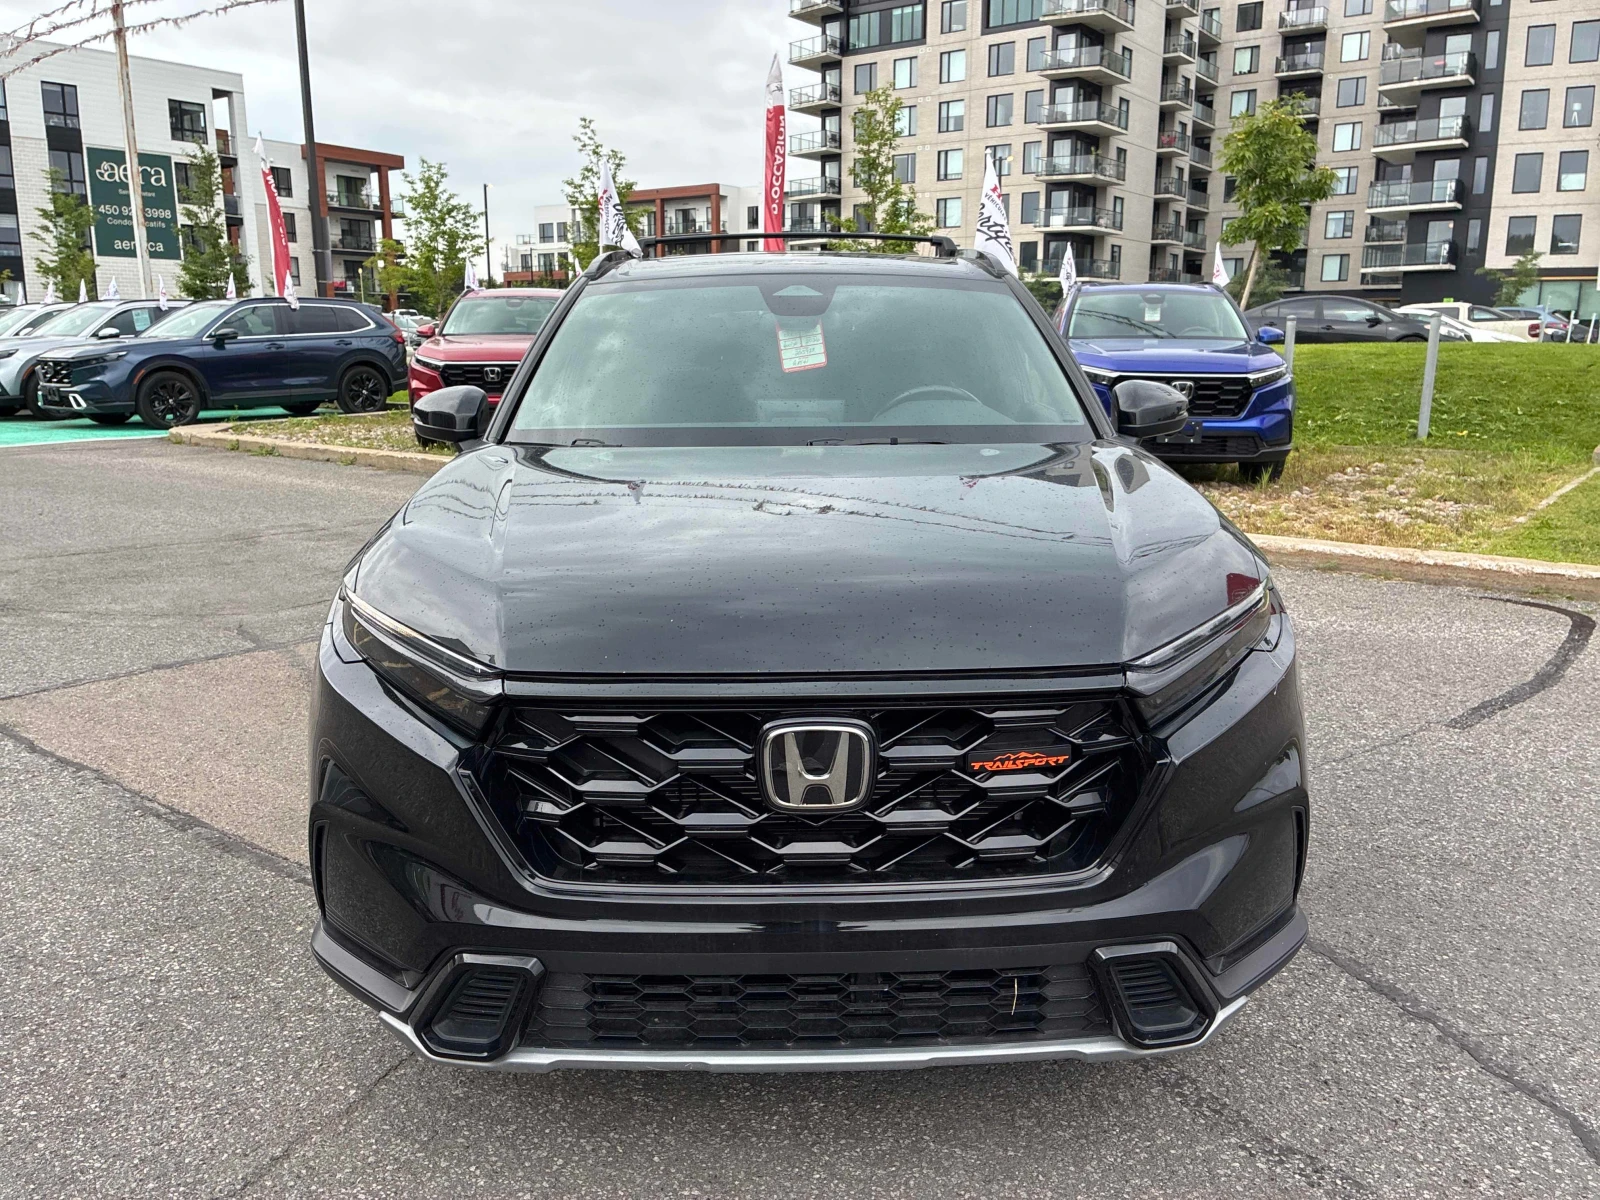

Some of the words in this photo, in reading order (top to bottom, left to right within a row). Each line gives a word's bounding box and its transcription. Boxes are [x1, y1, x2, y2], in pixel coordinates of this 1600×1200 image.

[102, 161, 167, 187] aera
[98, 204, 119, 215] 450
[106, 217, 132, 226] Condo
[144, 221, 166, 229] catifs
[970, 755, 1069, 771] TRAILSPORT
